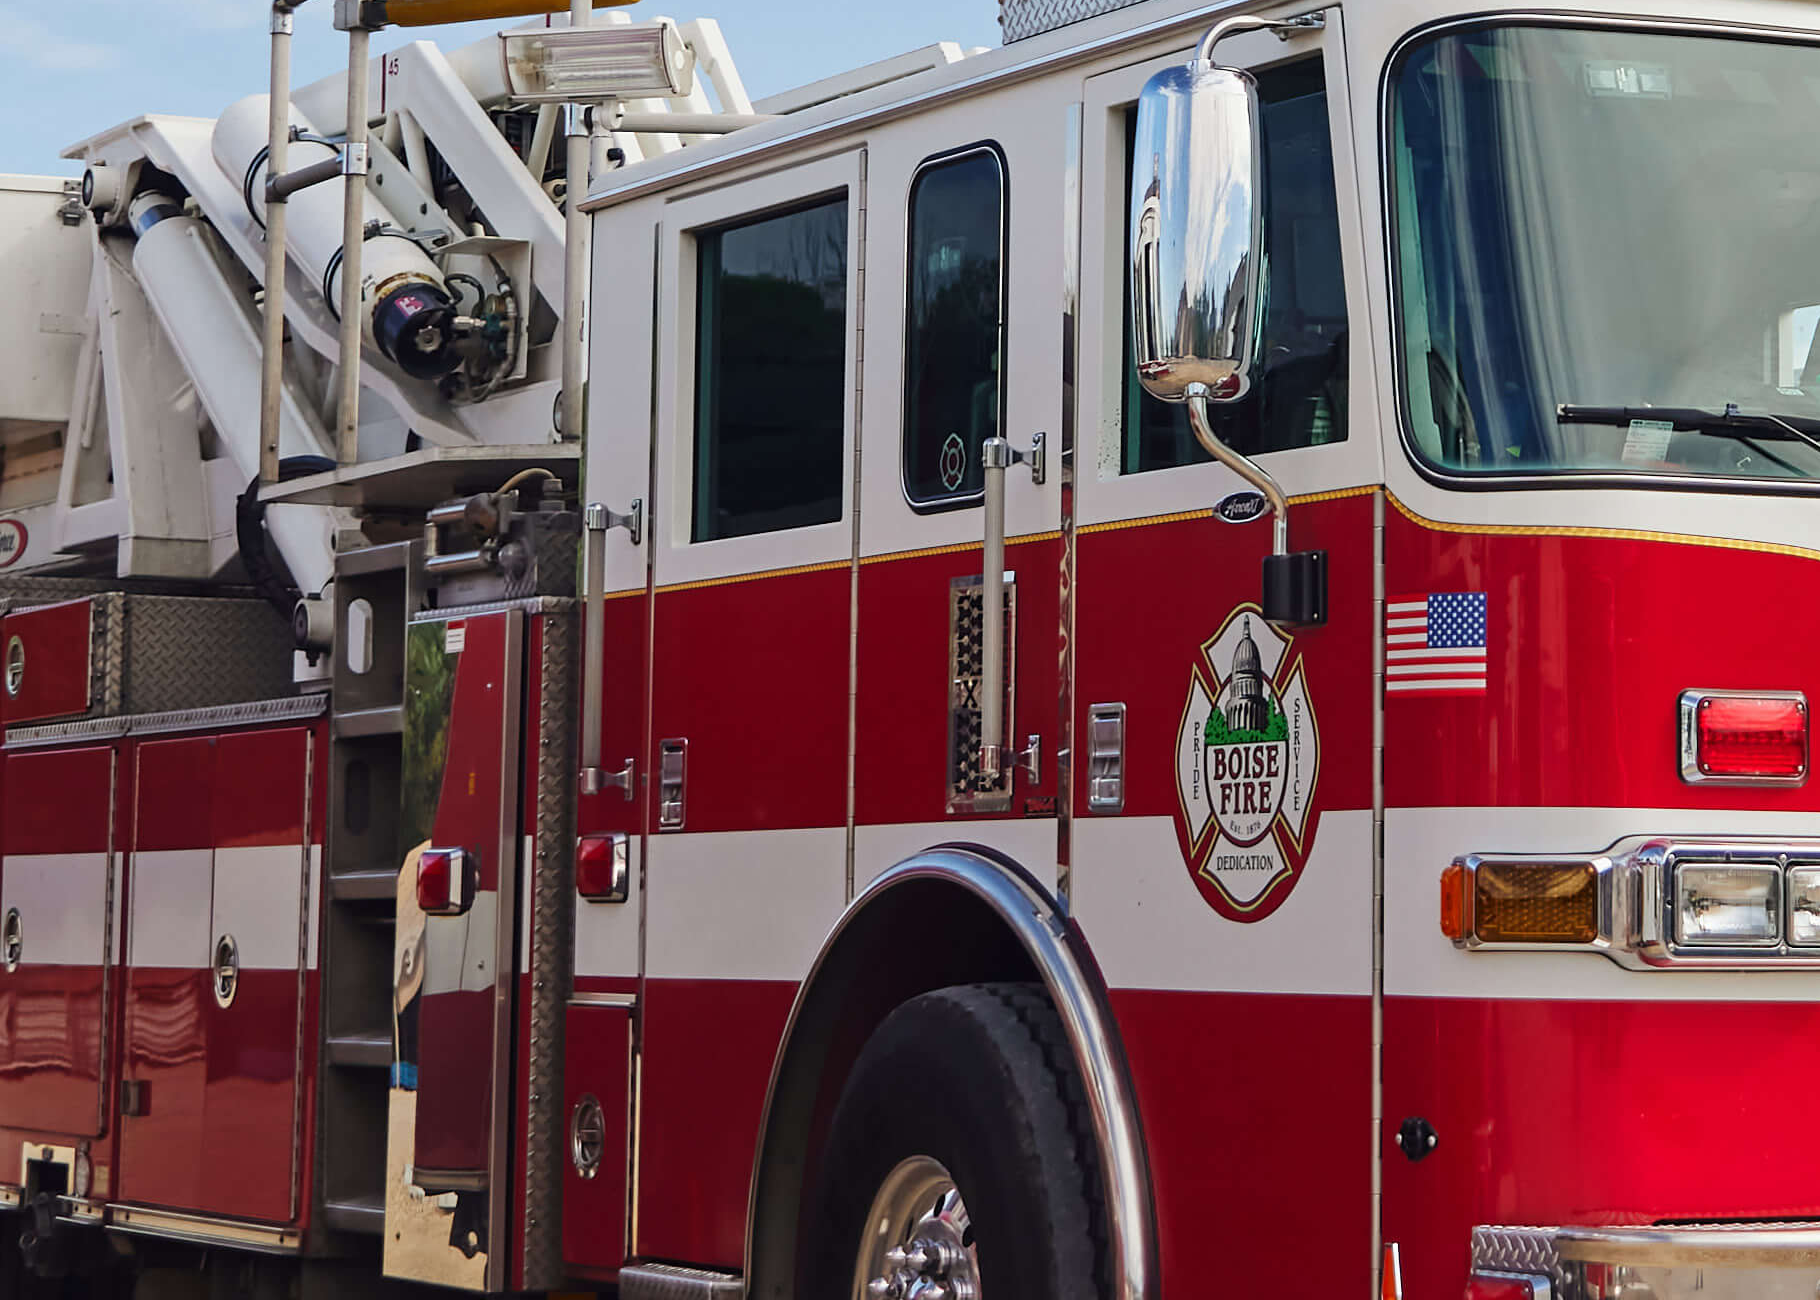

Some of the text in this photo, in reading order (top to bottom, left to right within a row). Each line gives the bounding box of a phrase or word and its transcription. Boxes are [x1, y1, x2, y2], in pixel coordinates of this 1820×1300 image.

[1193, 722, 1201, 800] PRIDE
[1213, 745, 1279, 781] BOISE
[1293, 698, 1301, 811] SERVICE
[1220, 781, 1272, 815] FIRE
[1216, 855, 1274, 871] DEDICATION
